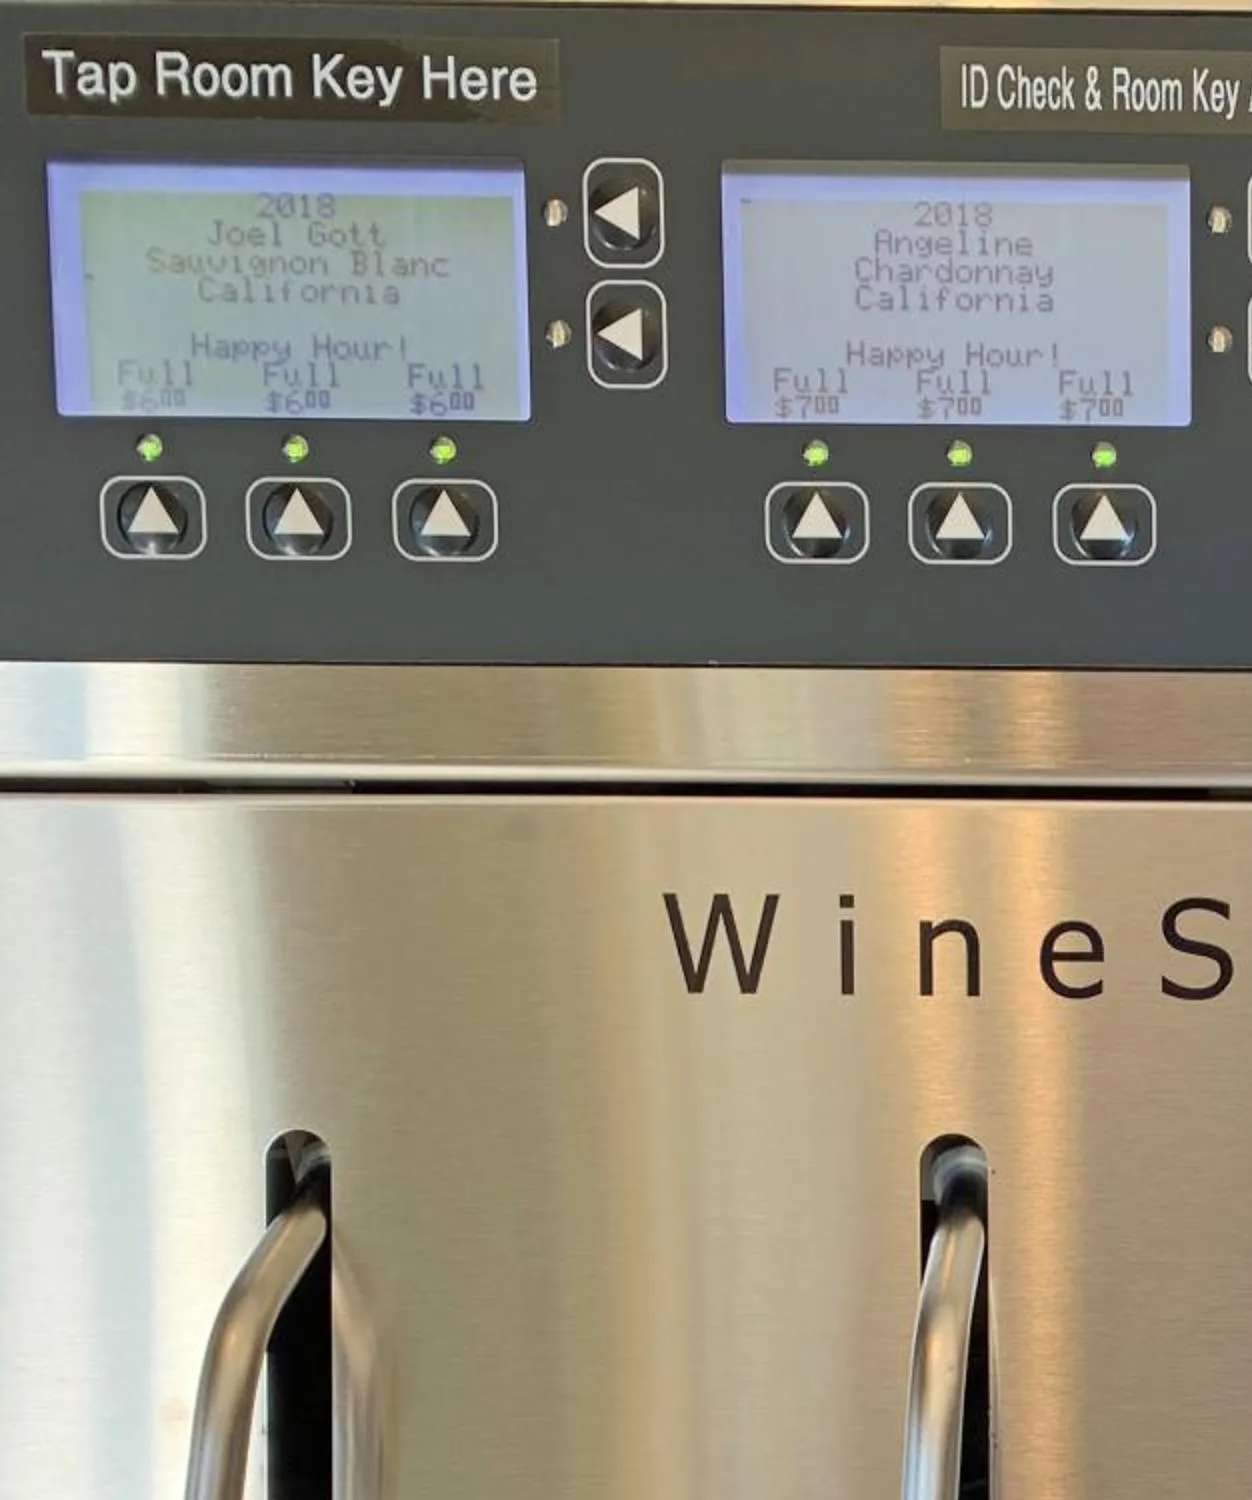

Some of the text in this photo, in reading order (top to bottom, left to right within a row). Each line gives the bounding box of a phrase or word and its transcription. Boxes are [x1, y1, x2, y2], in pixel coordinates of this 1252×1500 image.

[42, 49, 537, 108] Tap Room Key Here
[961, 65, 989, 107] ID
[997, 66, 1075, 110] Check
[1085, 67, 1101, 110] &
[1113, 69, 1183, 112] Room
[1192, 69, 1239, 122] Key
[256, 193, 336, 219] 2018
[914, 201, 993, 228] 2018
[207, 220, 386, 248] Joel Gott
[874, 228, 1032, 258] Angeline
[146, 247, 451, 277] Sauvignon Blanc
[855, 258, 1053, 287] Chardonnay
[198, 278, 400, 305] California
[855, 286, 1053, 312] California
[191, 333, 407, 365] Happy Hour!
[846, 341, 1060, 372] Happy Hour!
[118, 360, 484, 390] Full Full Full
[774, 368, 1134, 398] Full Full Full
